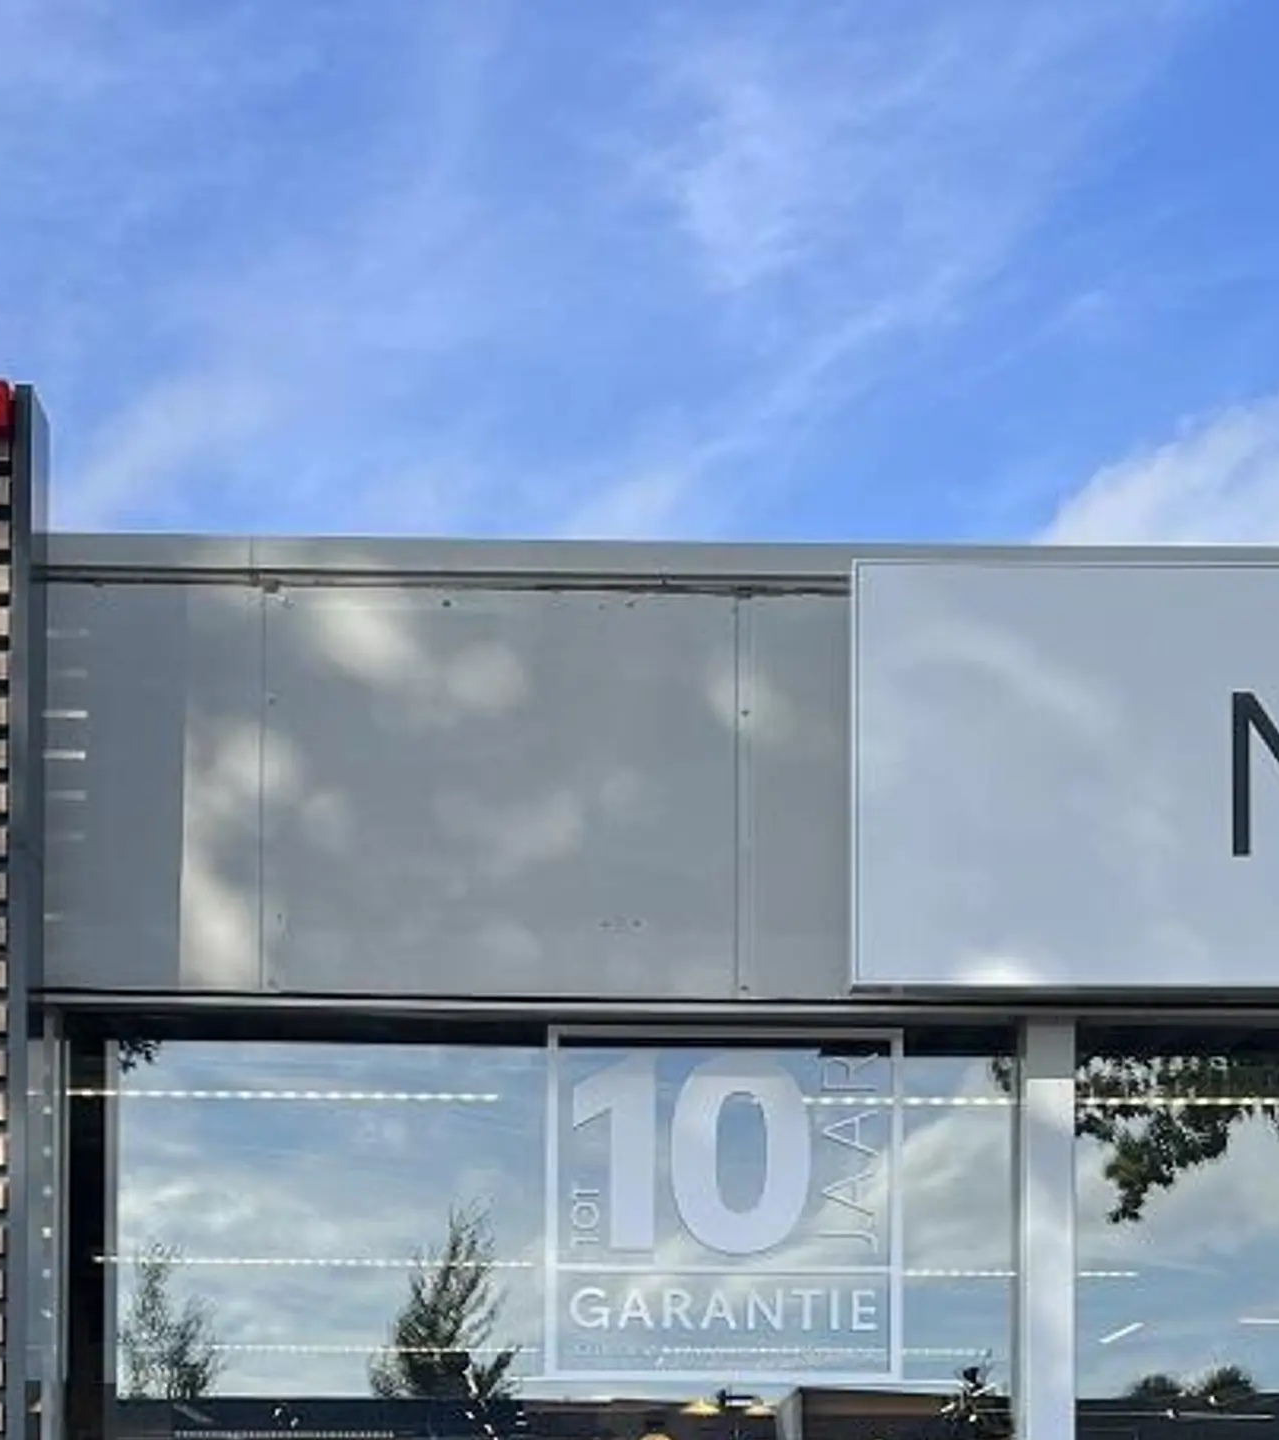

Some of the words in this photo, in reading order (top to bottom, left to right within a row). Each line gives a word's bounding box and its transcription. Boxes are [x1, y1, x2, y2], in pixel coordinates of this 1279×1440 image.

[573, 1047, 812, 1256] 10
[816, 1053, 880, 1254] JAAR
[569, 1287, 879, 1332] GARANTIE
